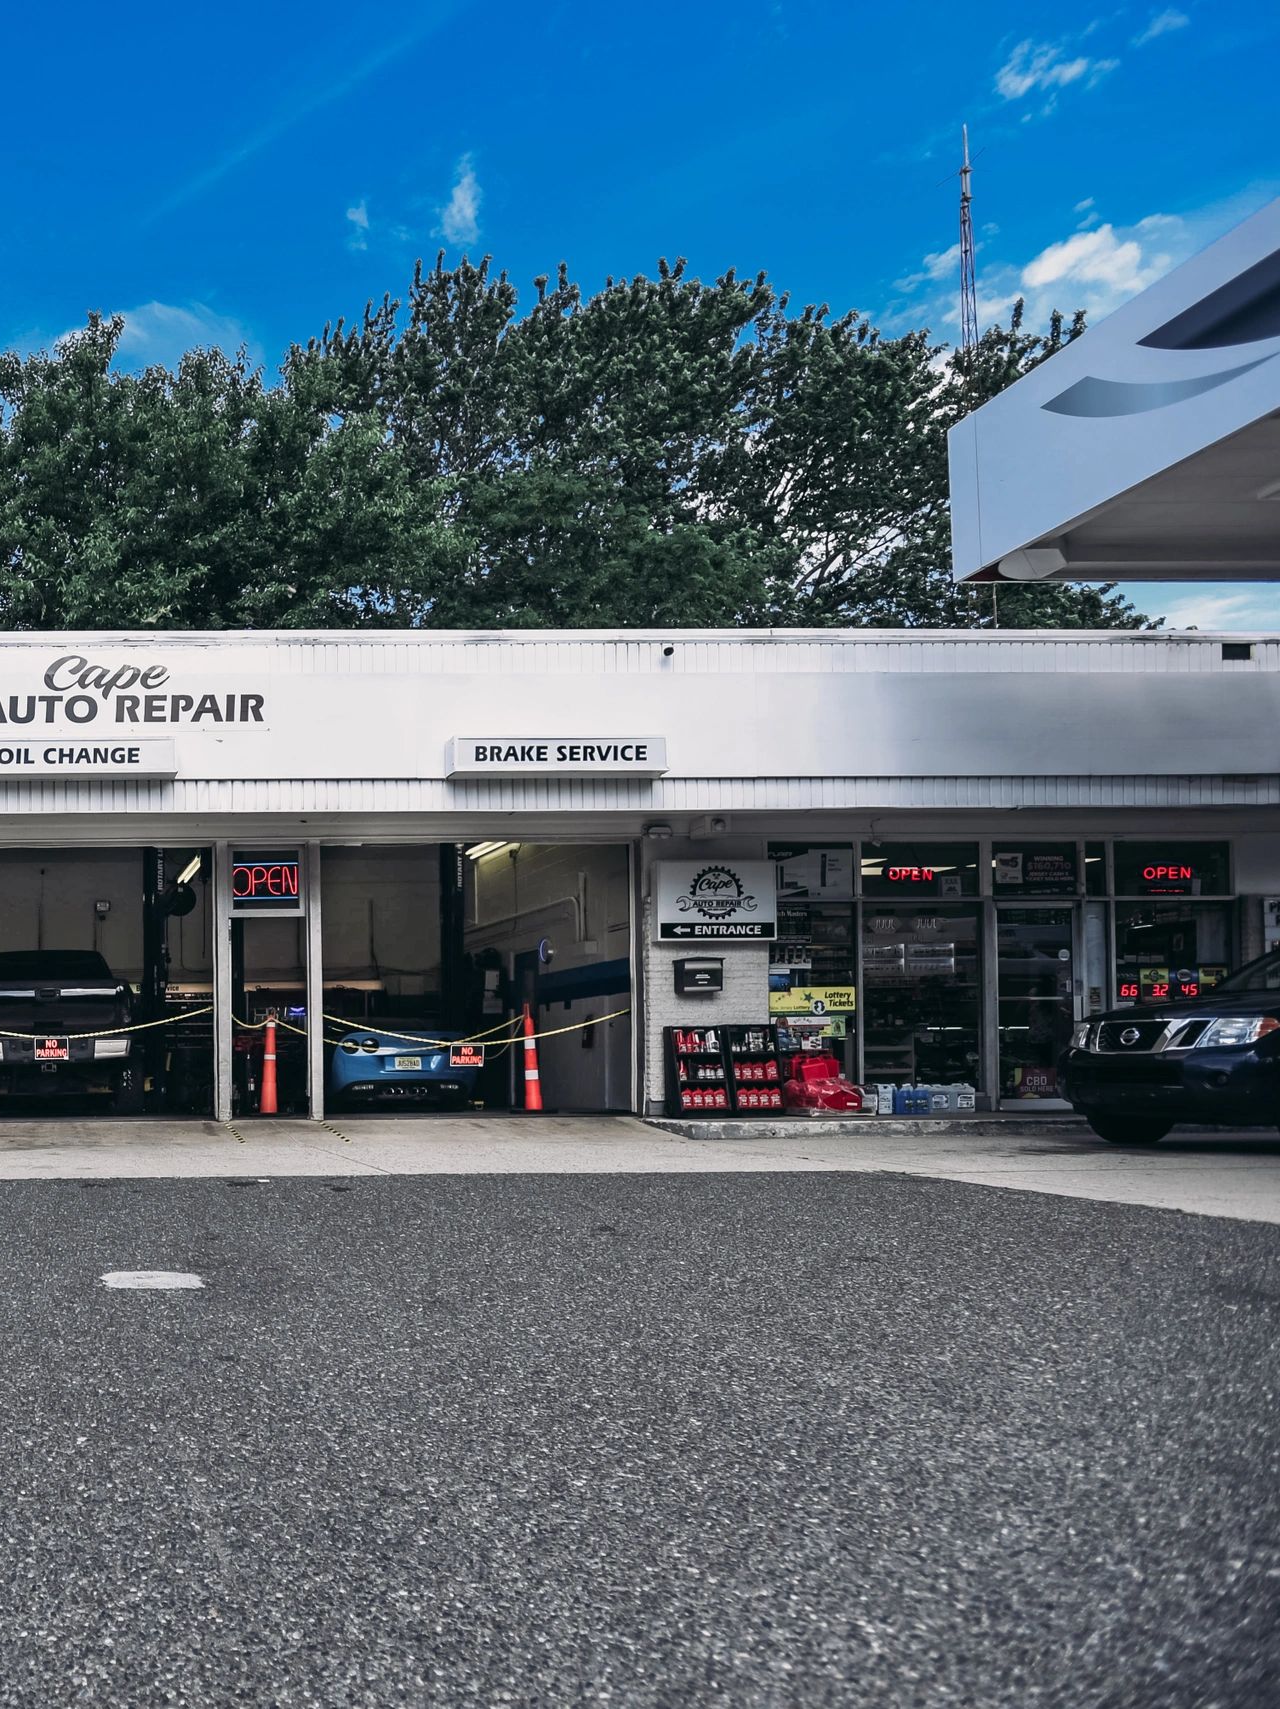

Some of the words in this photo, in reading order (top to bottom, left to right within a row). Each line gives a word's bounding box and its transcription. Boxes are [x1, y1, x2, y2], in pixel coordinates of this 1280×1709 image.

[43, 655, 170, 700] Cape
[114, 694, 265, 723] REPAIR
[42, 747, 141, 764] CHANGE
[474, 745, 549, 762] BRAKE
[556, 744, 648, 761] SERVICE
[887, 867, 934, 881] OPEN
[1142, 865, 1192, 880] OPEN
[233, 865, 298, 897] OPEN
[699, 879, 733, 892] Cape
[716, 900, 741, 908] REPAIR
[694, 925, 762, 935] ENTRANCE
[824, 991, 852, 1001] Lottery
[1120, 984, 1139, 997] 66
[1181, 983, 1198, 996] 45
[45, 1039, 58, 1049] NO
[36, 1048, 67, 1058] PARKING
[461, 1046, 474, 1056] NO
[451, 1055, 483, 1065] PARKING
[1026, 1076, 1048, 1086] CBD
